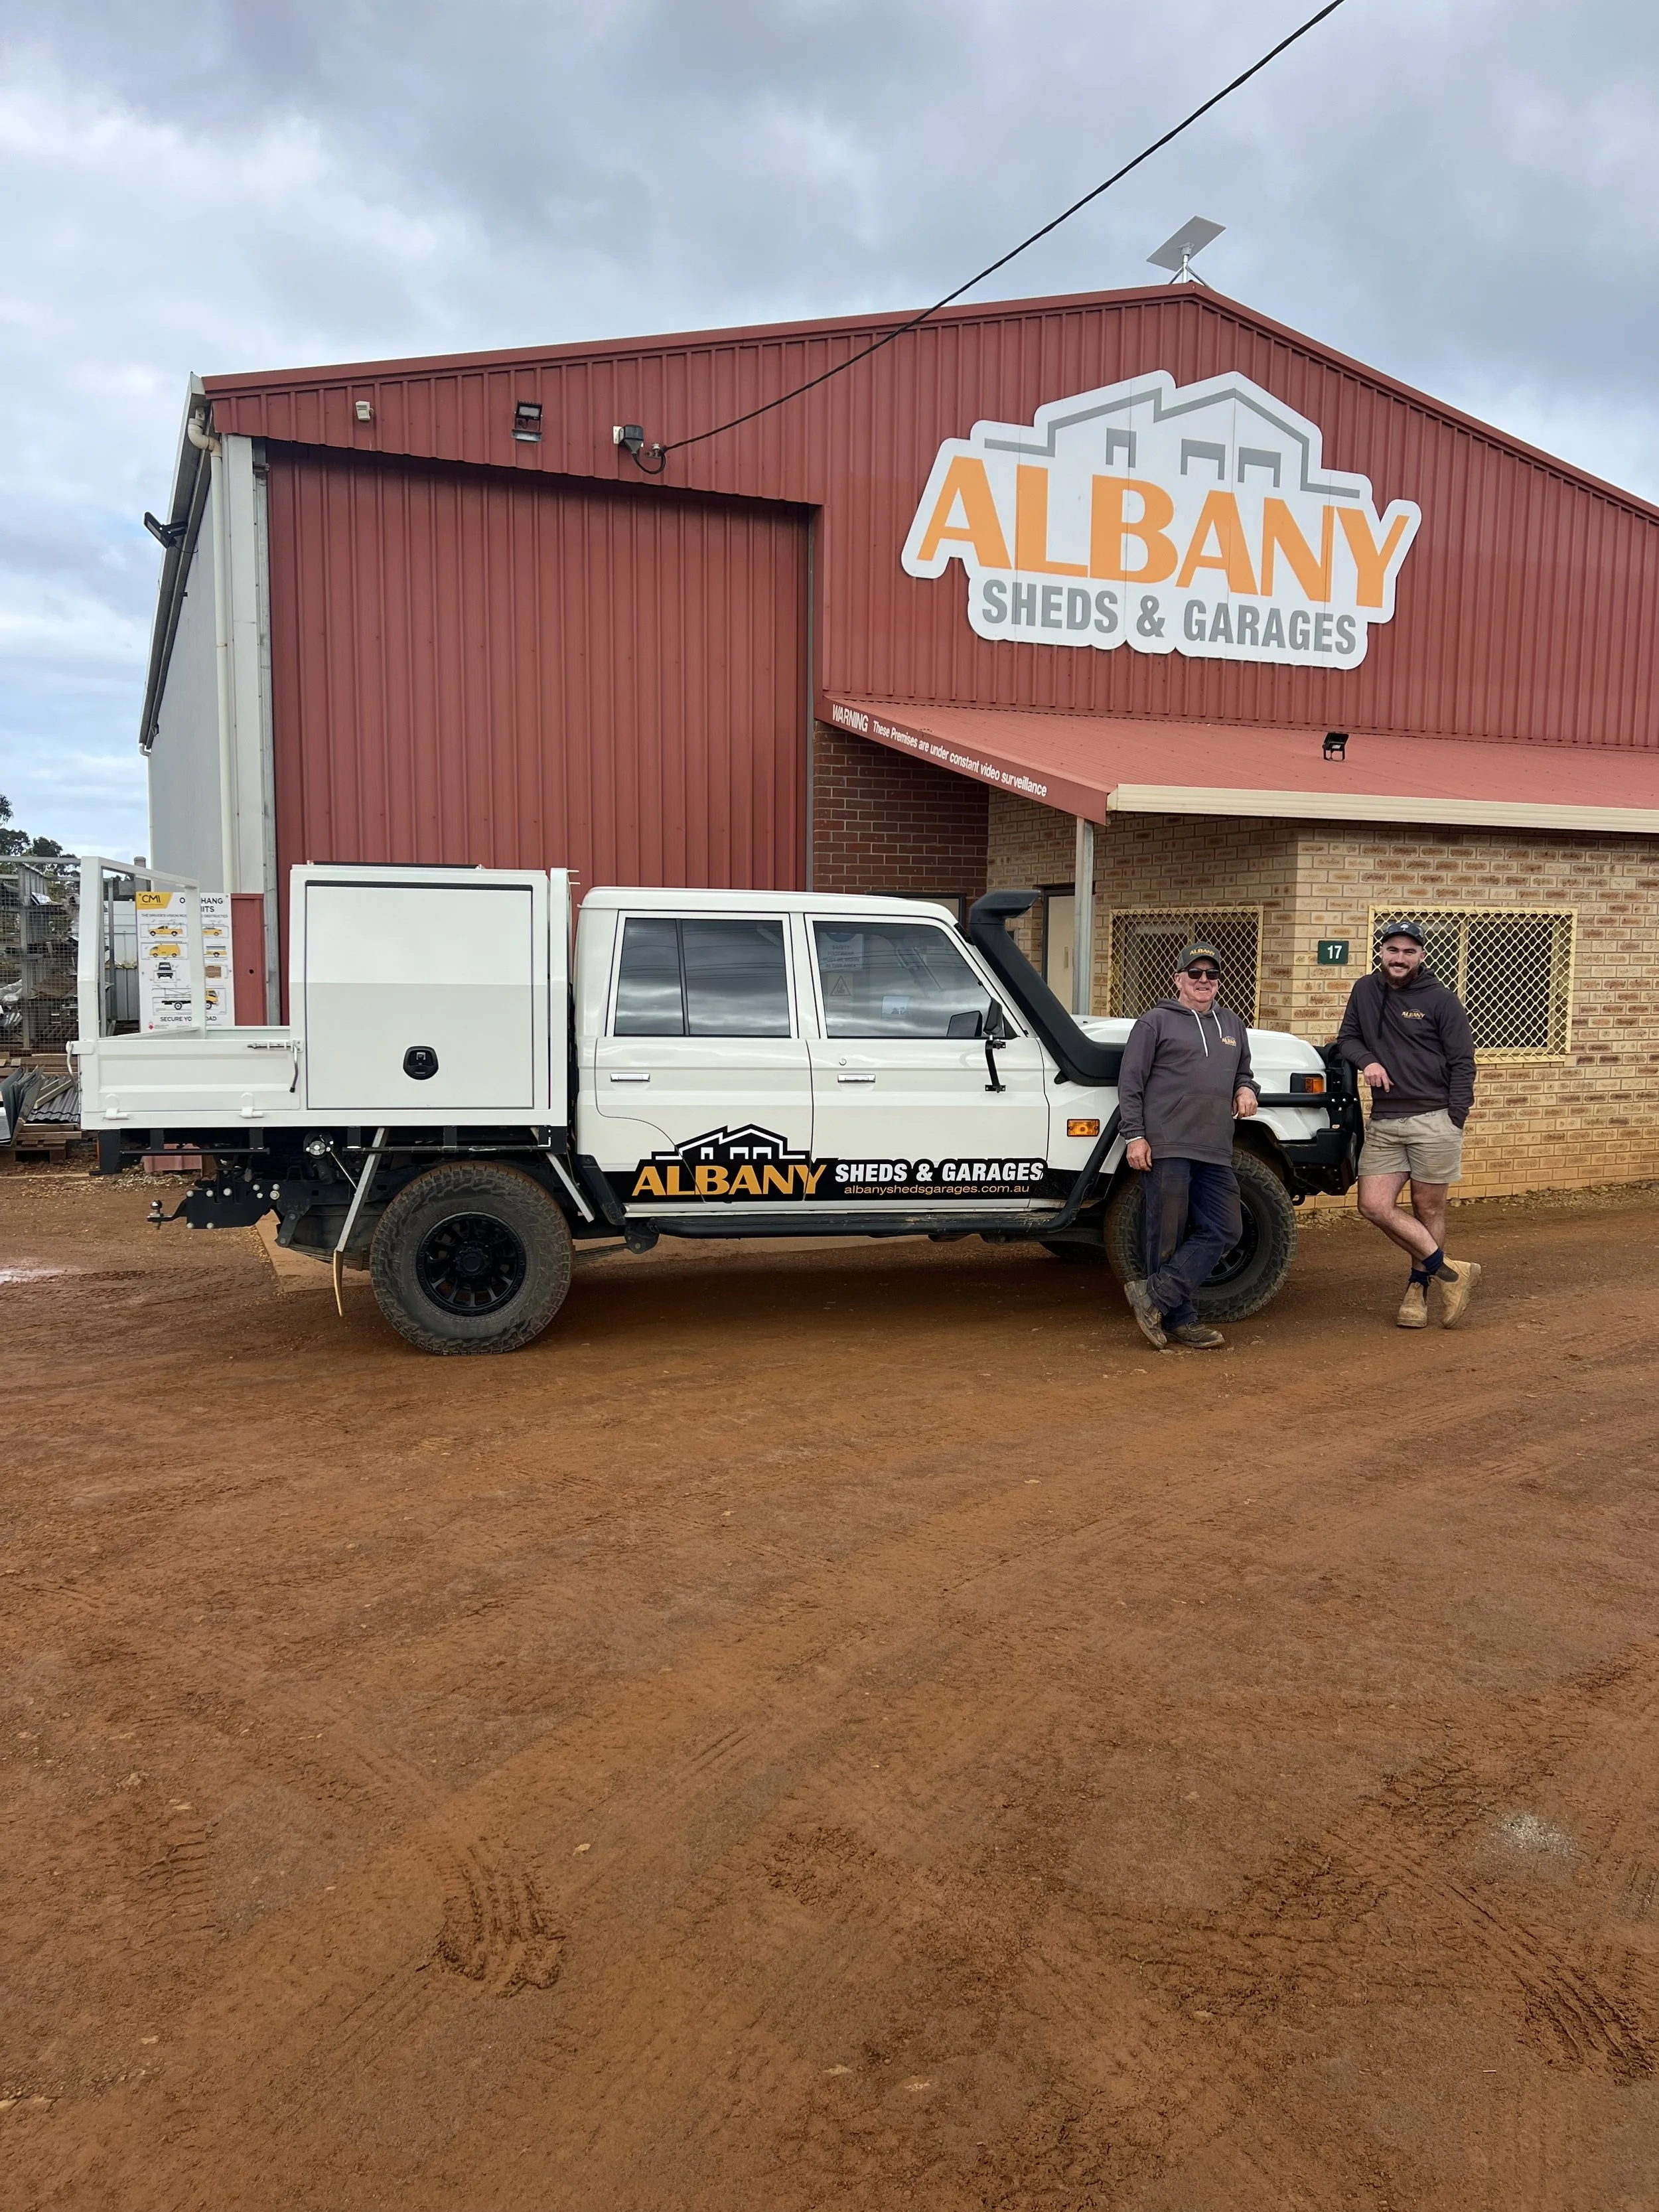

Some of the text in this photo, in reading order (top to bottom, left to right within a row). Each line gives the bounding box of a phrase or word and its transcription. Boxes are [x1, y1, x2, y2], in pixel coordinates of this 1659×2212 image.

[918, 455, 1409, 608] ALBANY
[982, 579, 1356, 655] SHEDS & GARAGES
[832, 704, 1048, 797] WARNING These Premises are under constant video surveillance
[1327, 945, 1342, 960] 17
[632, 1164, 827, 1197] ALBANY
[835, 1163, 1044, 1183] SHEDS & GARAGES
[844, 1184, 1029, 1195] albanyshedsgarages.com.au
